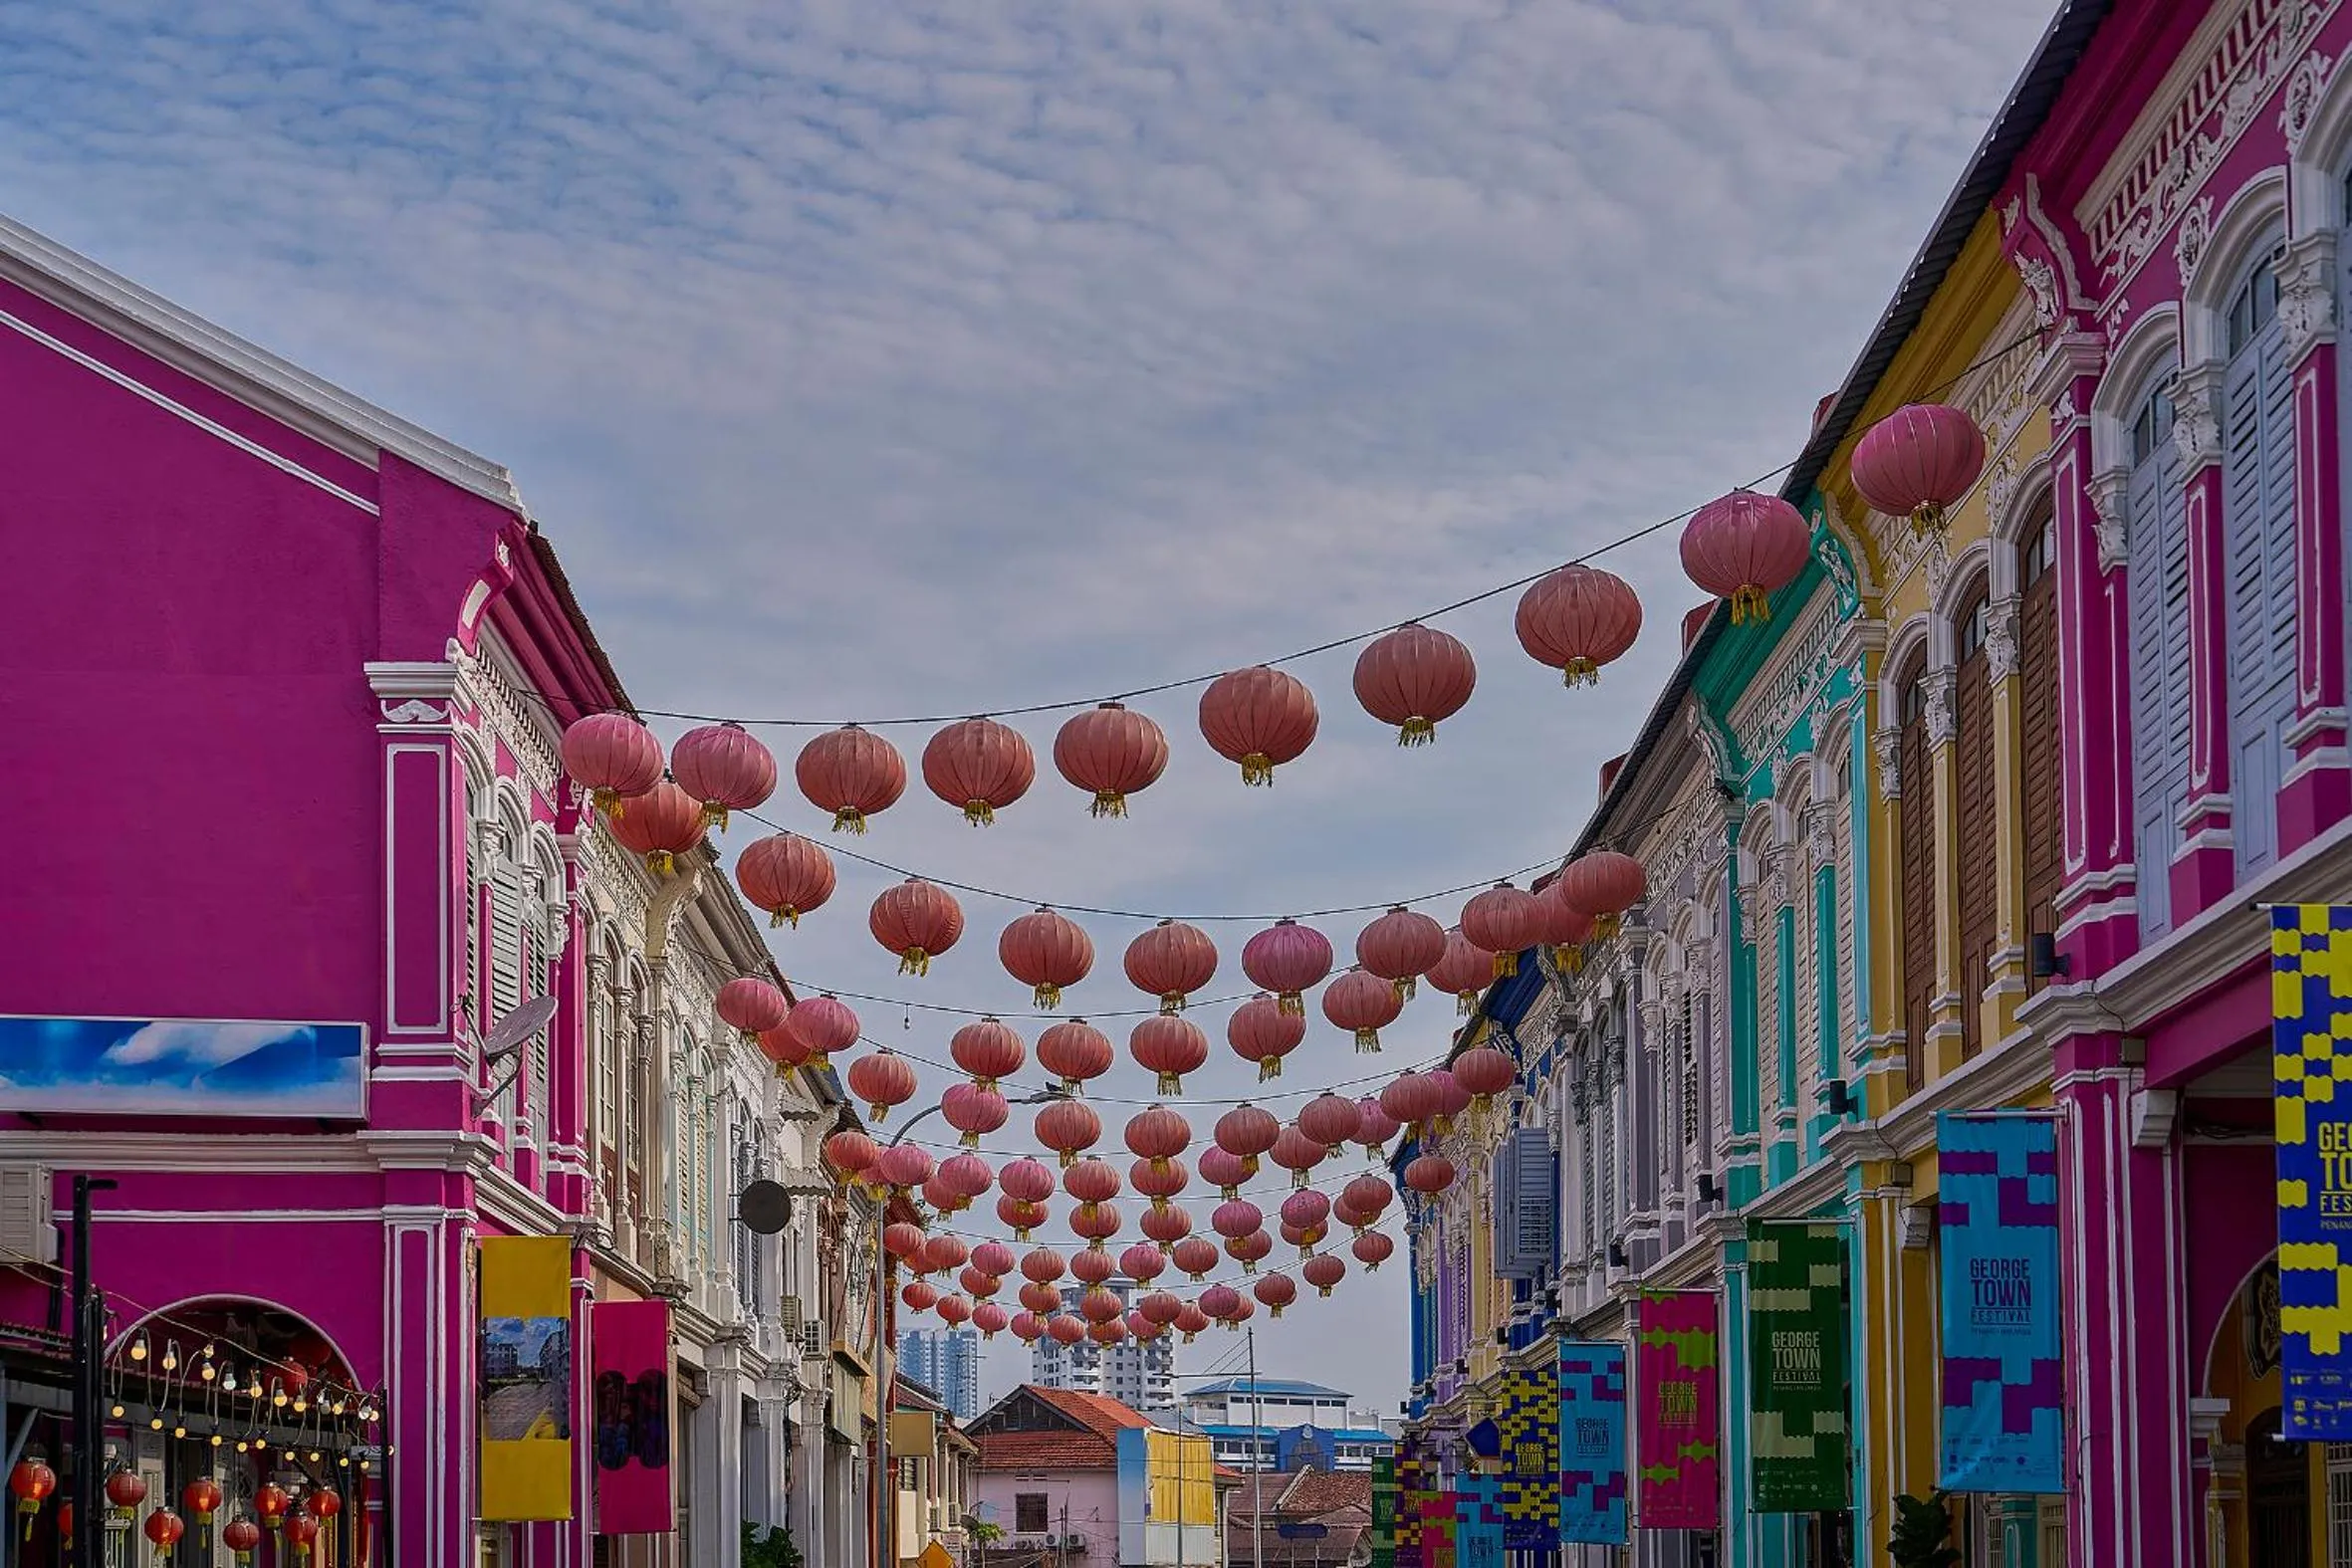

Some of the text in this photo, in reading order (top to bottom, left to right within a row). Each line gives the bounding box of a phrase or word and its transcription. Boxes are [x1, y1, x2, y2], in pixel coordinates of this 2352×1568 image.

[1970, 1258, 2030, 1279] GEORGE
[1971, 1279, 2030, 1306] TOWN
[1972, 1310, 2030, 1322] FESTIVAL
[1771, 1331, 1820, 1347] GEORGE
[1772, 1348, 1821, 1369] TOWN
[1772, 1371, 1820, 1380] FESTIVAL
[1658, 1382, 1698, 1394] GEORGE
[1657, 1395, 1698, 1412] TOWN
[1577, 1430, 1609, 1445] TOWN
[1516, 1454, 1544, 1465] TOWN
